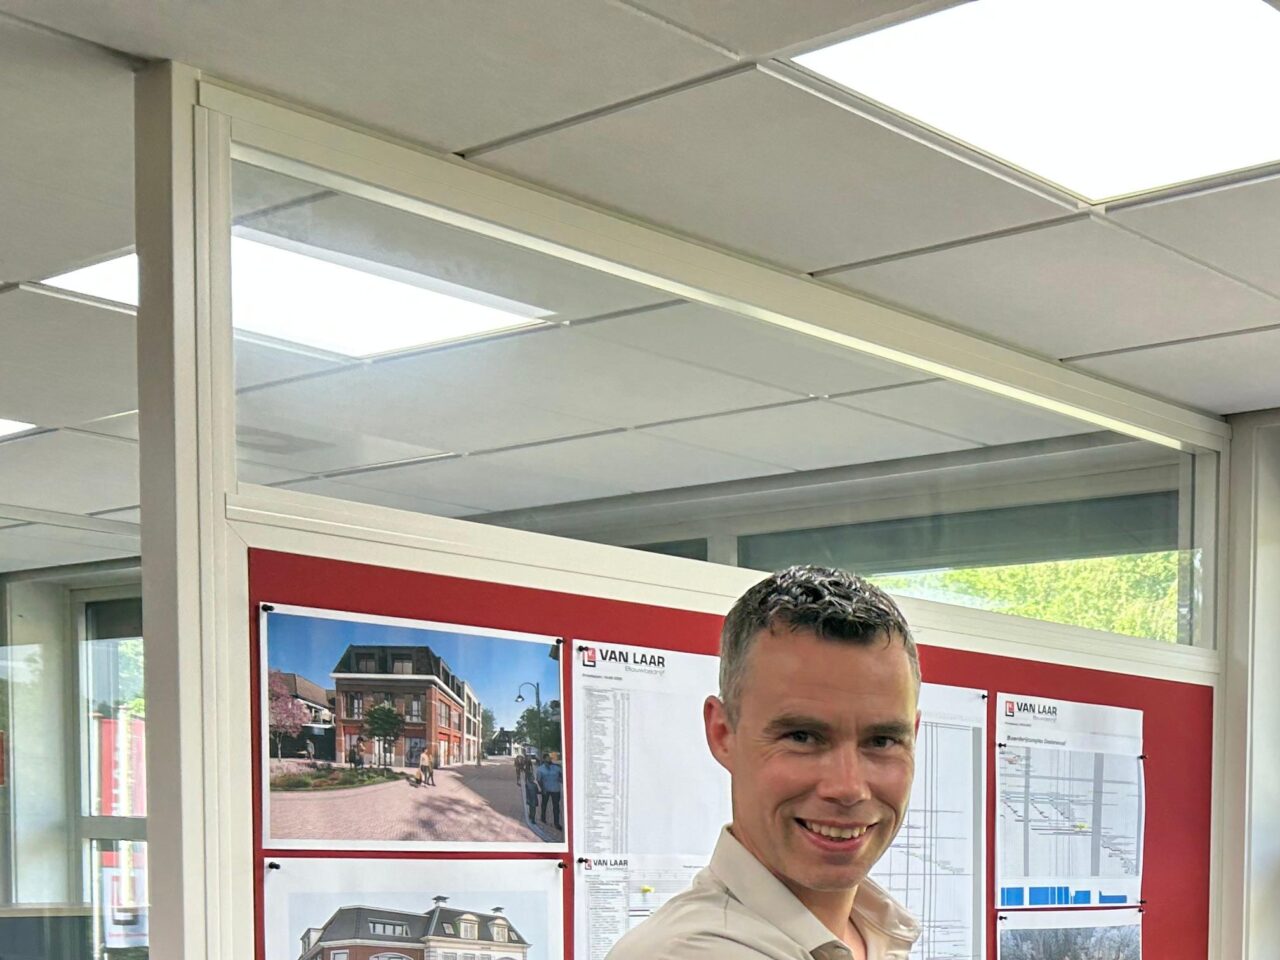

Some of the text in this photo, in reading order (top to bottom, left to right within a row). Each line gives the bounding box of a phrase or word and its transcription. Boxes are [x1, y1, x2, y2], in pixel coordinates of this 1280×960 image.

[599, 649, 666, 667] VAN LAAR
[1016, 702, 1057, 715] VAN LAAR
